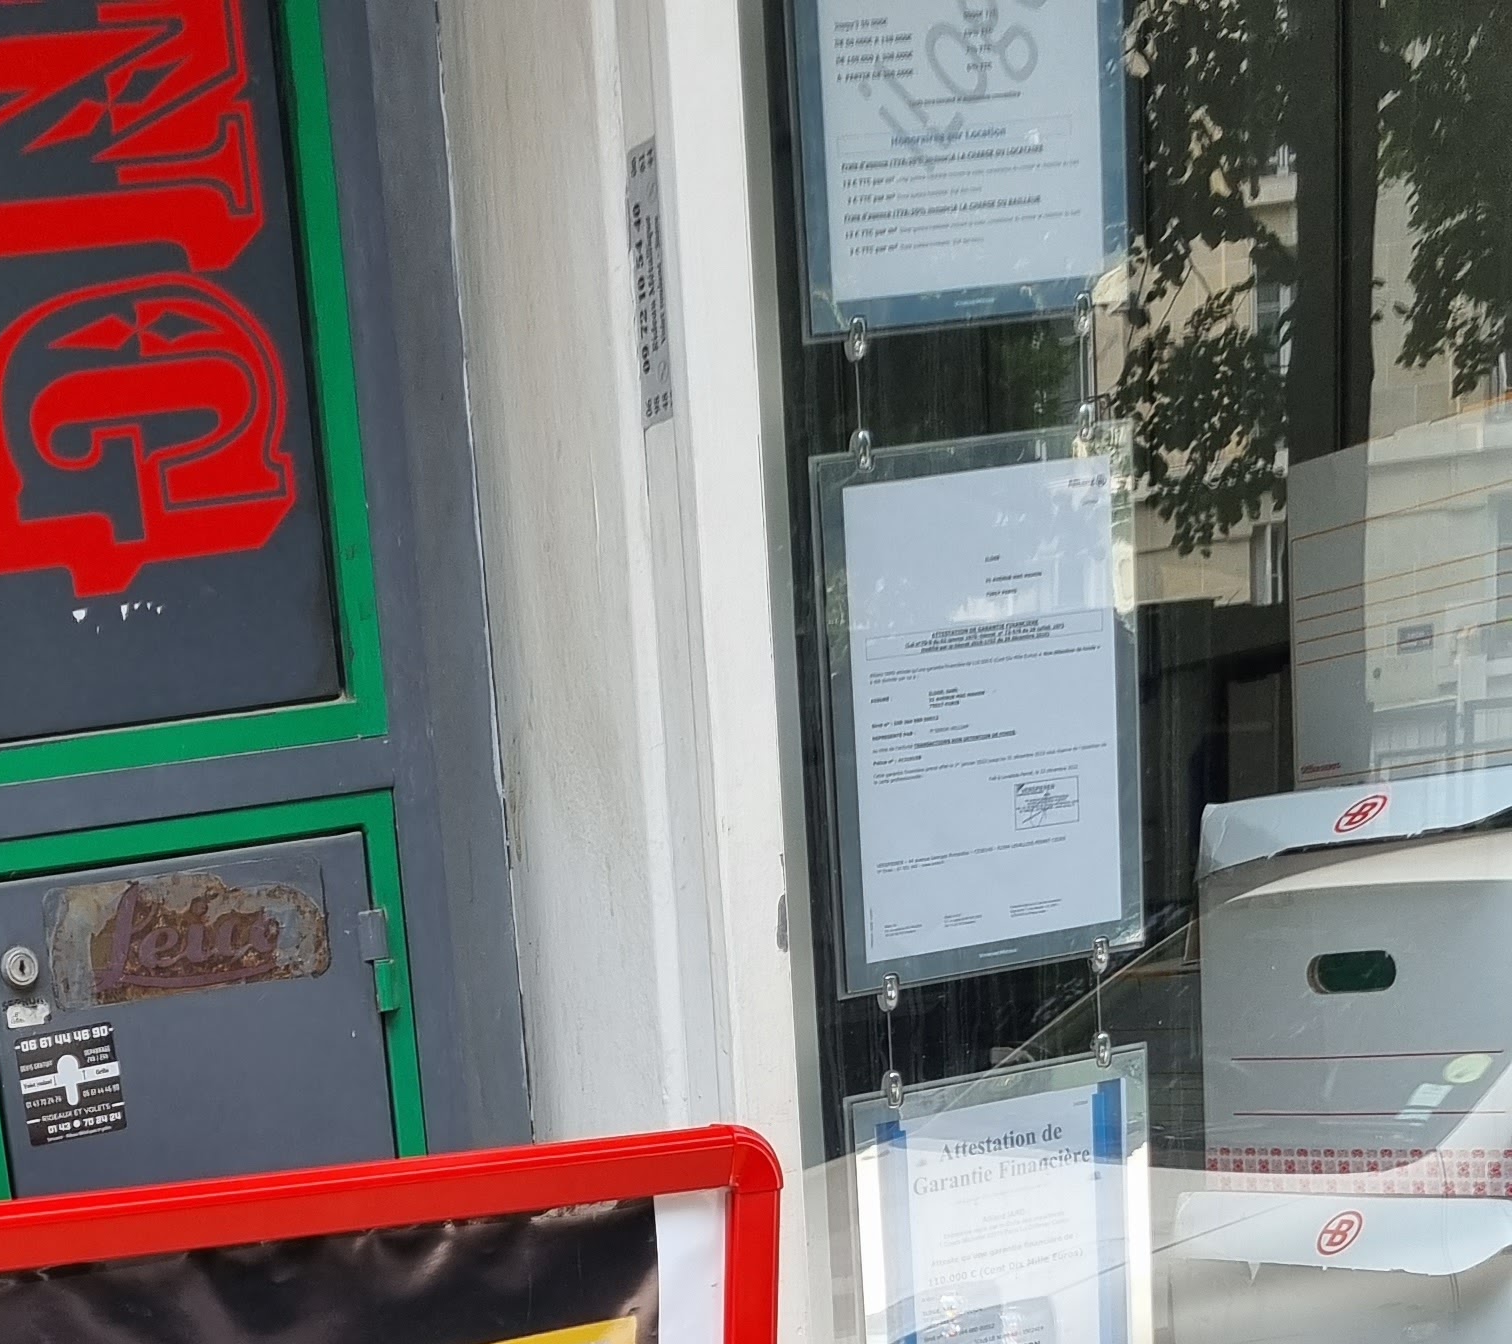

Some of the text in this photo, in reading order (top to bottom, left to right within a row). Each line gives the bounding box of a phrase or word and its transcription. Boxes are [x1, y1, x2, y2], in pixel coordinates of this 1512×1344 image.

[637, 275, 646, 304] 10
[54, 1032, 72, 1045] 44
[939, 1123, 1063, 1162] Attestation de
[913, 1147, 1091, 1196] Garantie Financière
